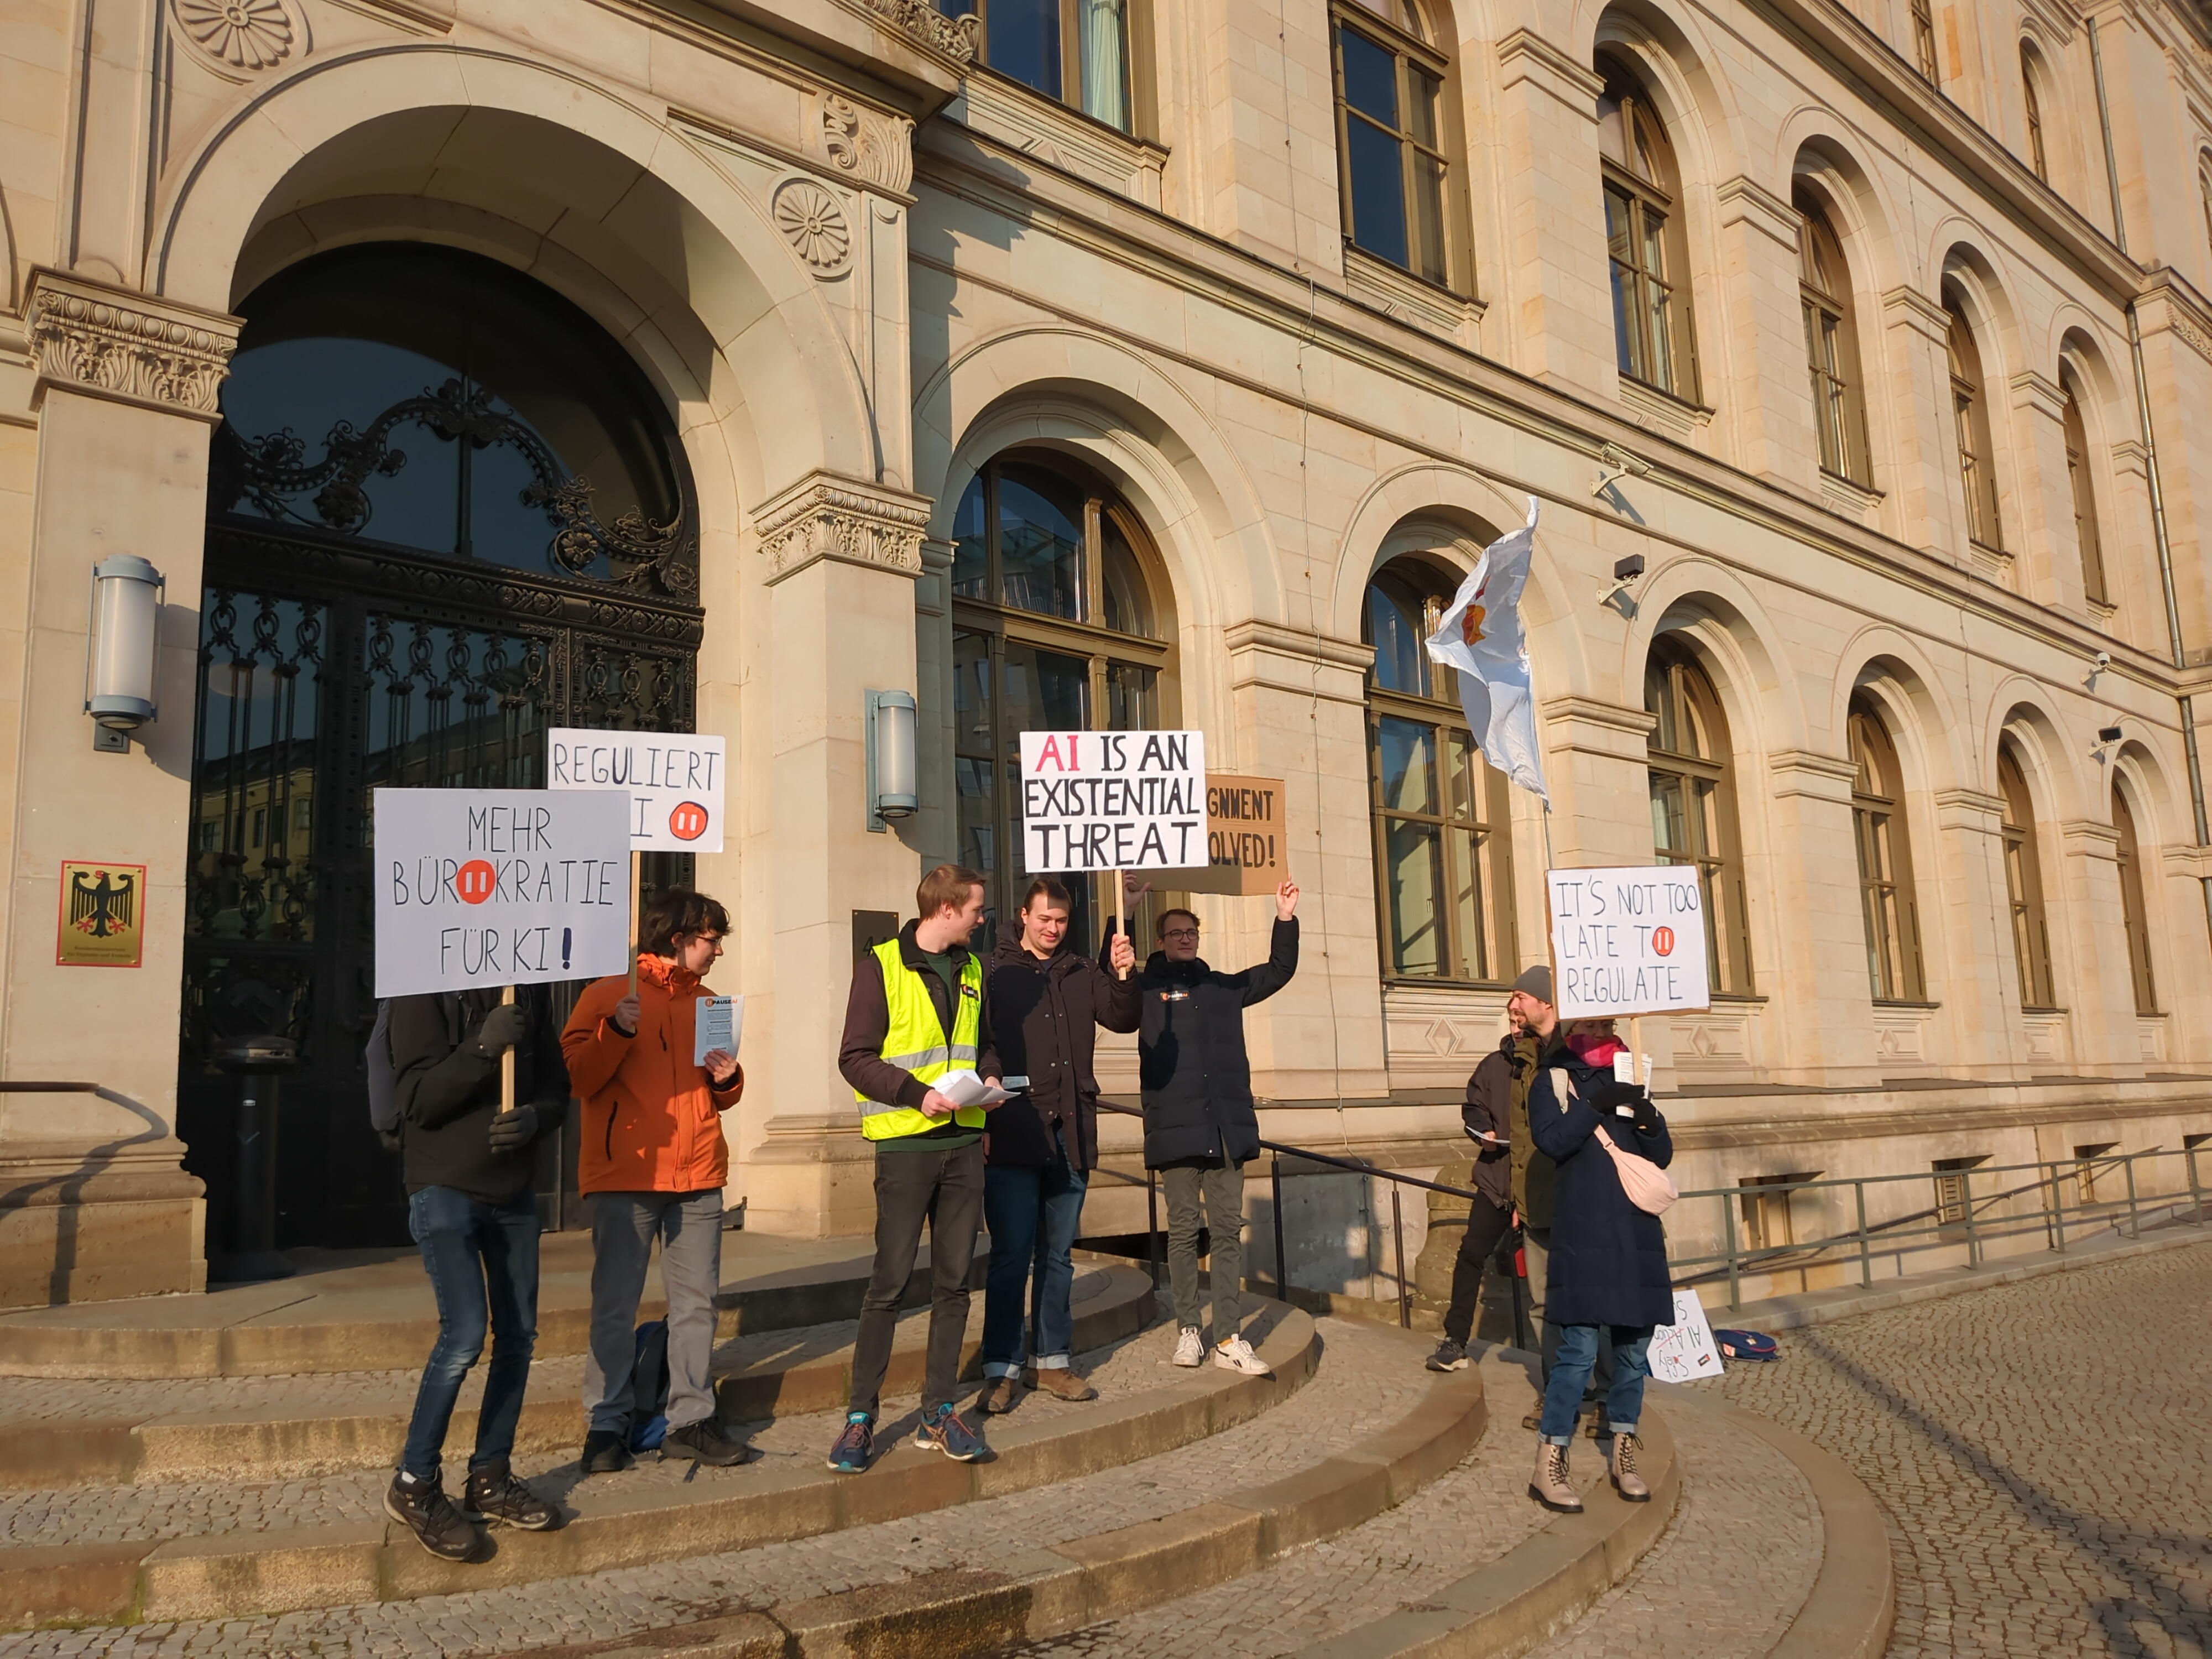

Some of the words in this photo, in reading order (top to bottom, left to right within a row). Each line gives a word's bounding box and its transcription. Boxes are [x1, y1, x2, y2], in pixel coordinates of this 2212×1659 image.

[555, 743, 719, 791] REGULIERT
[1035, 734, 1081, 773] AI
[1100, 735, 1126, 771] IS
[1138, 734, 1188, 771] AN
[1025, 778, 1200, 818] EXISTENTIAL
[1207, 787, 1274, 821] GNMENT
[468, 806, 552, 853] MEHR
[1031, 822, 1198, 868] THREAT
[1208, 831, 1276, 868] OLVED!
[1556, 875, 1605, 917] IT'S
[1618, 884, 1656, 915] NOT
[1663, 883, 1698, 914] TOO
[442, 927, 500, 975] FÜR
[1562, 925, 1619, 959] LATE
[1567, 966, 1683, 1003] REGULATE
[1687, 1326, 1700, 1348] AI
